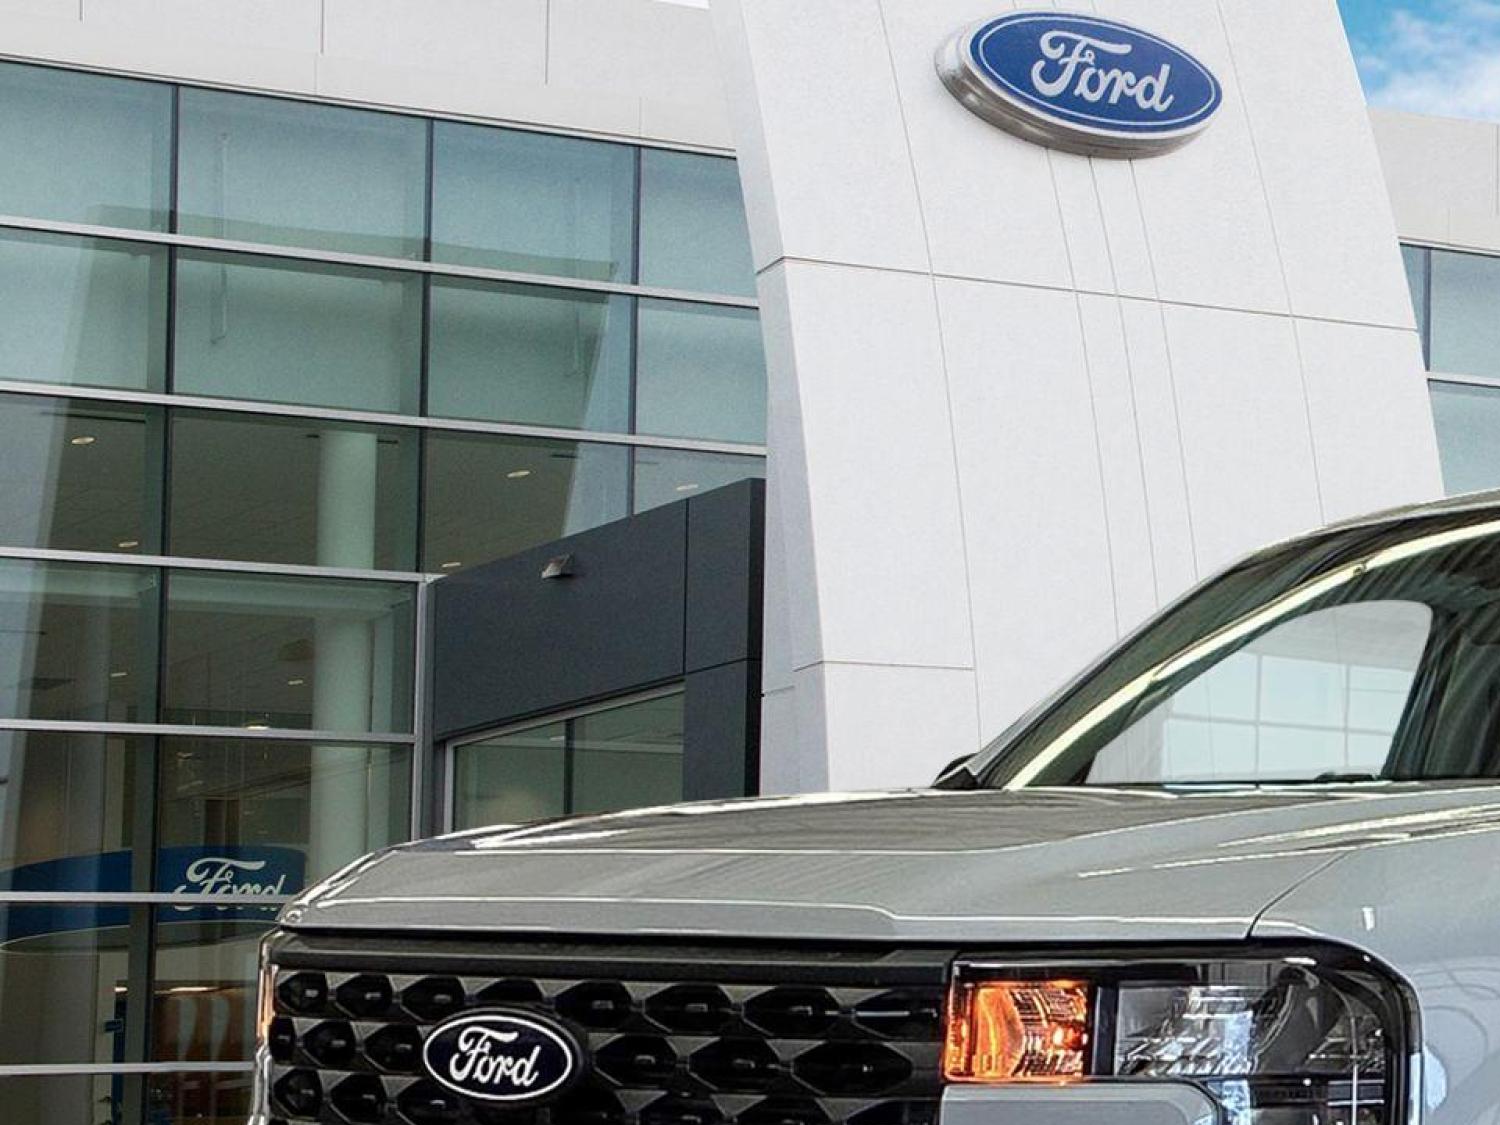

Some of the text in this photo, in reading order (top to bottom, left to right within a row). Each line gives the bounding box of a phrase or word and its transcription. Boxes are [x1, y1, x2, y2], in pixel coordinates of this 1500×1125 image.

[1031, 30, 1174, 112] Ford
[173, 857, 287, 911] Ford
[449, 1026, 542, 1087] Ford
